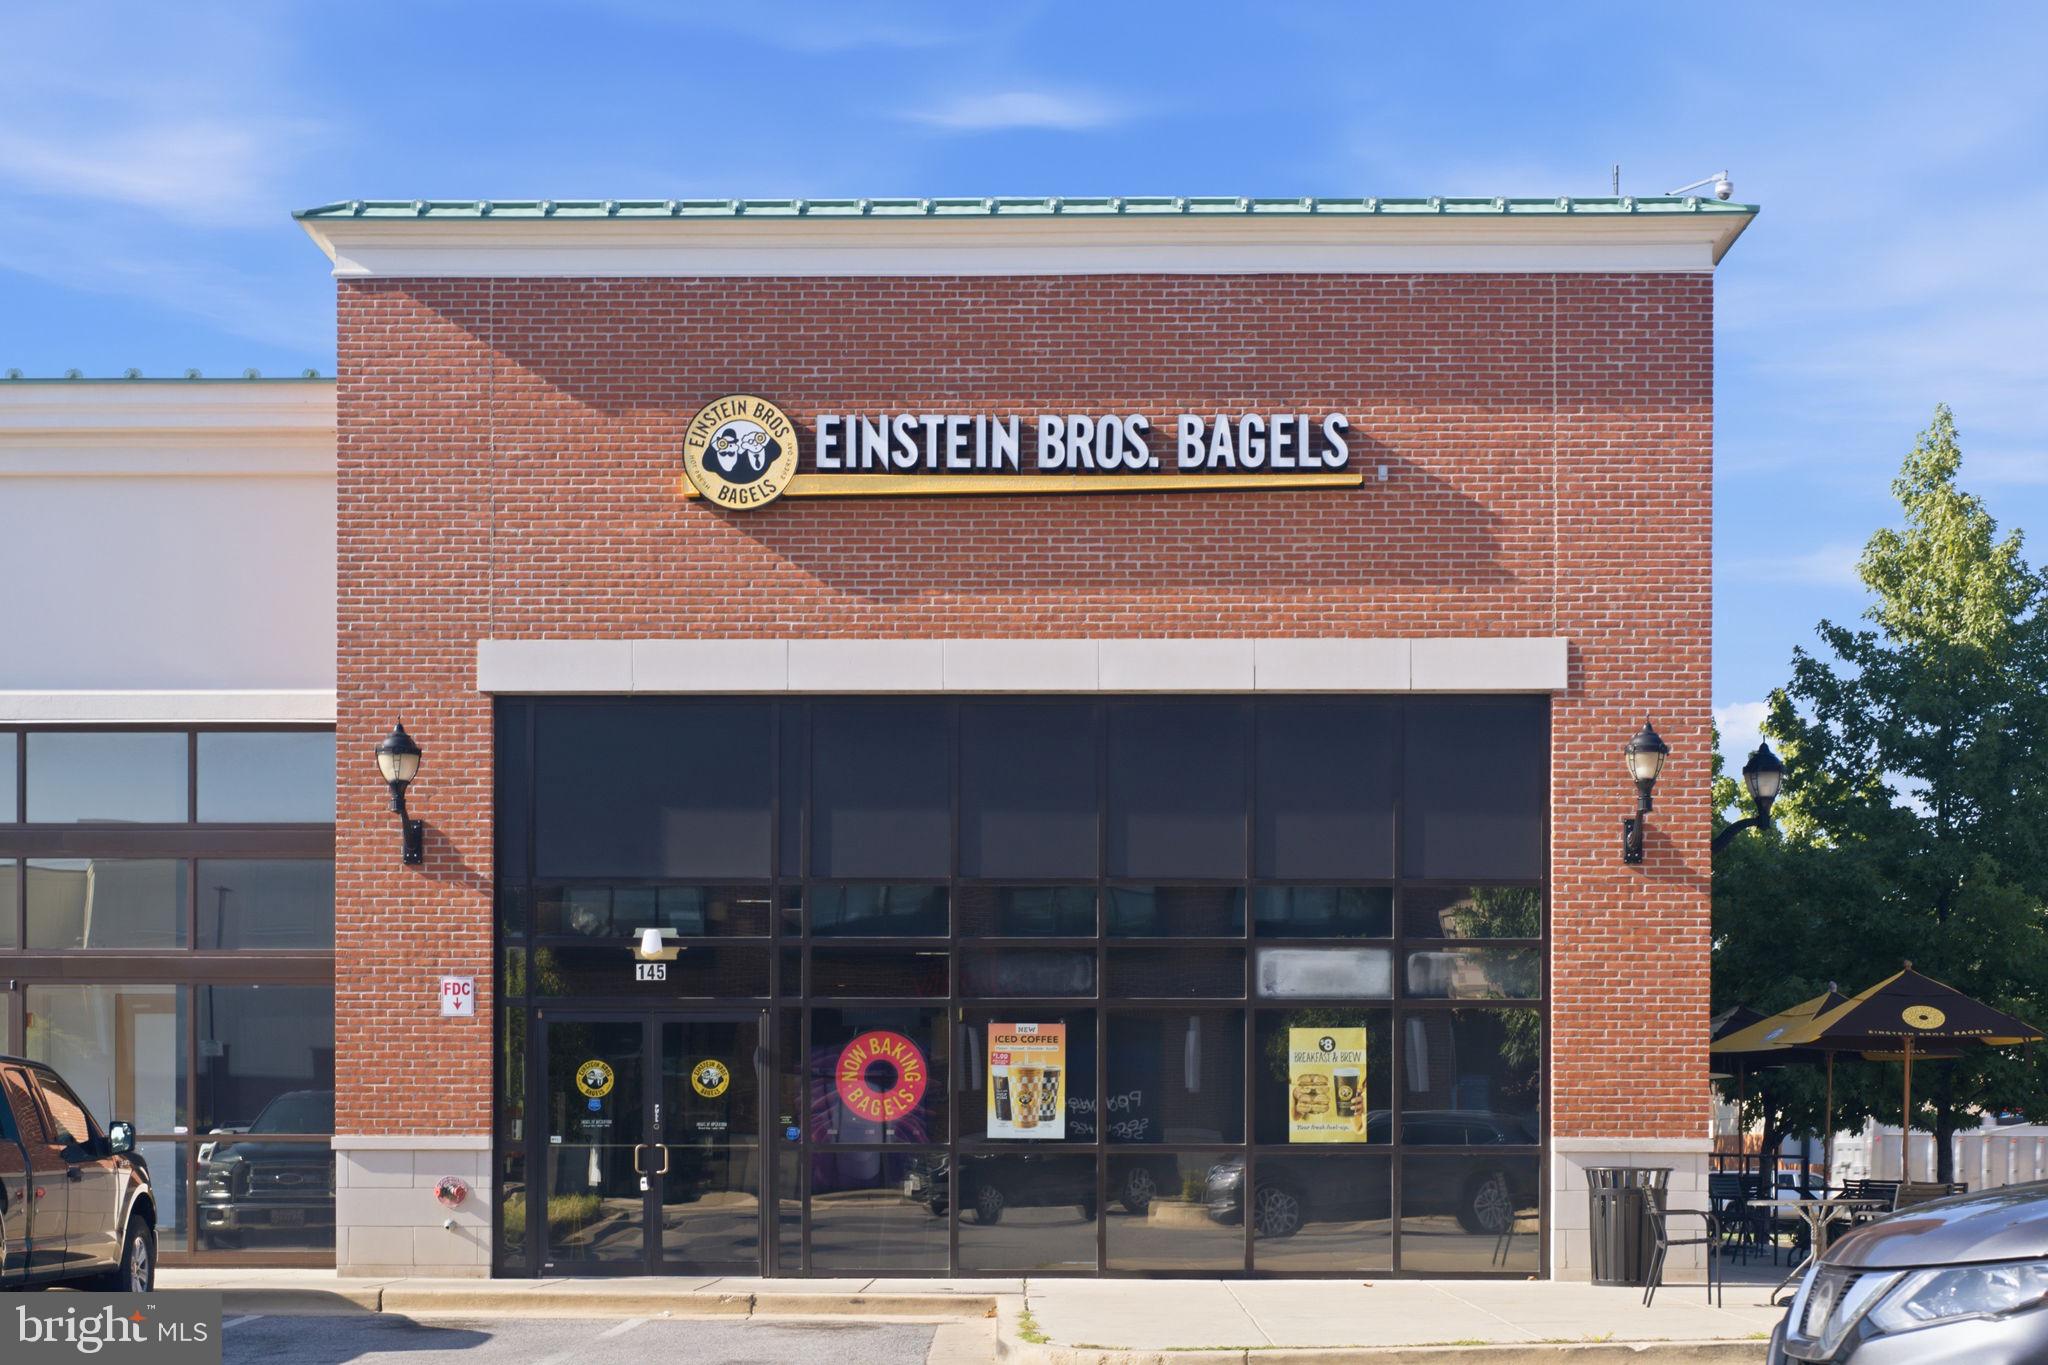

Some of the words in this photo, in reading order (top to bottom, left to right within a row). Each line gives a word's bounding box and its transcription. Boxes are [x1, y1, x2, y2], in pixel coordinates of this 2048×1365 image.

[689, 400, 747, 448] EINSTEIN
[753, 403, 790, 438] BROS
[816, 413, 1020, 472] EINSTEIN
[1038, 413, 1159, 469] BROS.
[1178, 412, 1349, 468] BAGELS
[717, 479, 777, 505] BAGELS
[638, 964, 665, 980] 145
[443, 982, 470, 996] FDC
[995, 1035, 1018, 1044] ICED
[1020, 1035, 1059, 1044] COFFEE
[841, 1044, 867, 1082] NOW
[869, 1037, 922, 1082] BAKING
[1294, 1051, 1331, 1063] BREAKFAST
[1332, 1052, 1338, 1063] &
[1340, 1051, 1362, 1063] BREW
[848, 1087, 915, 1116] BAGELS
